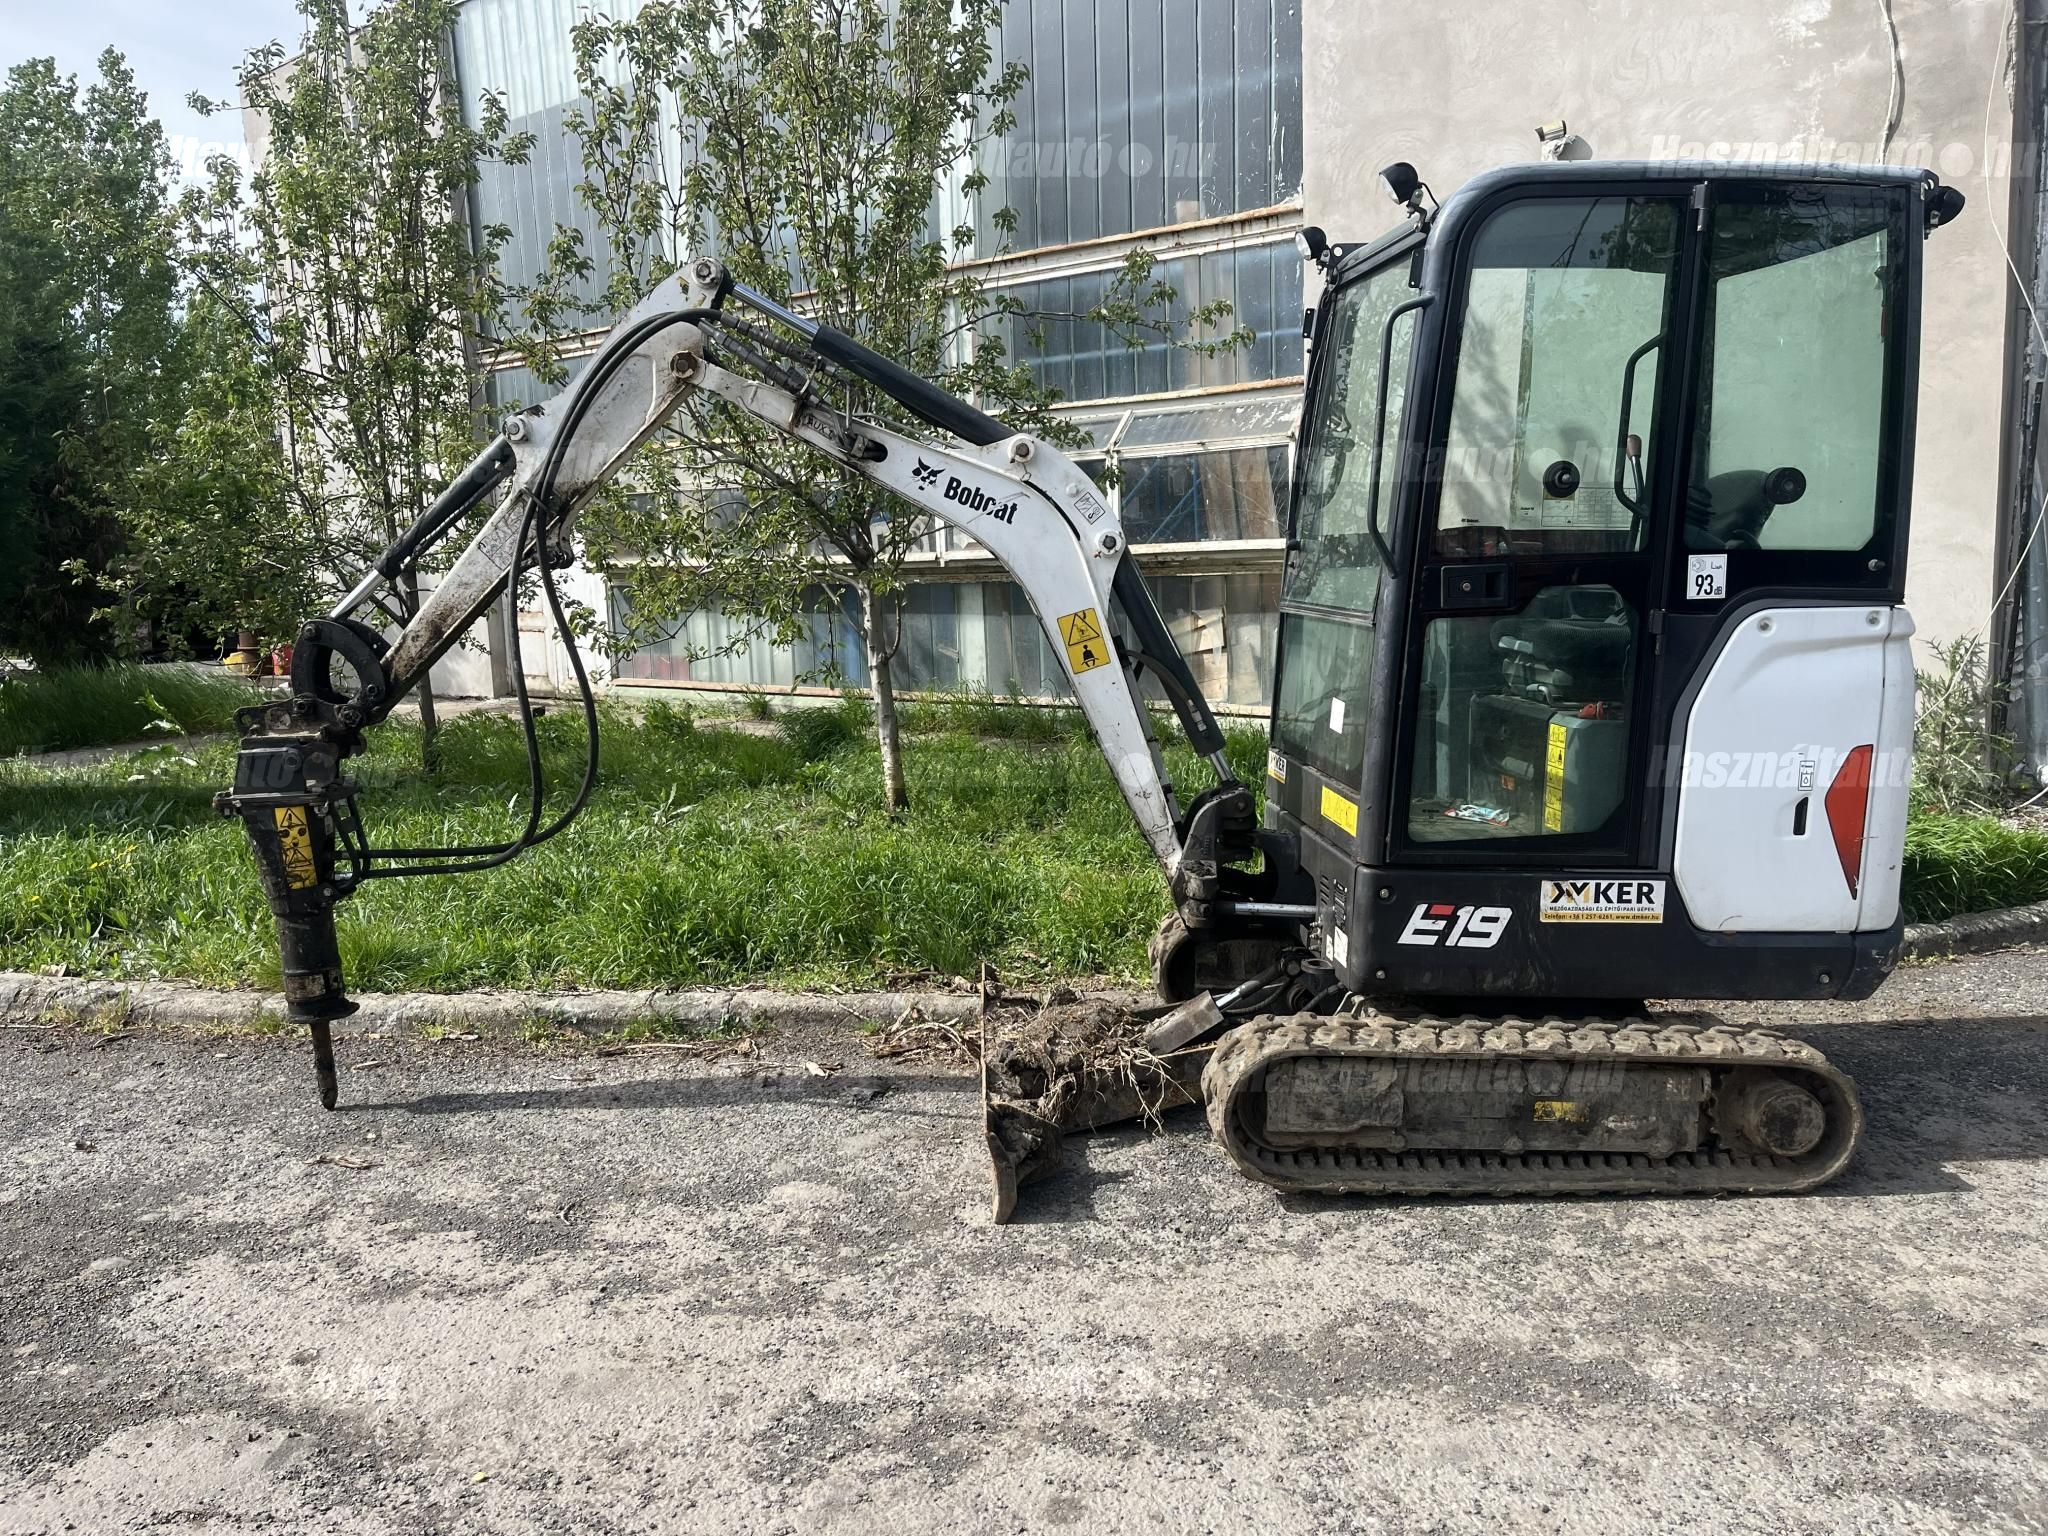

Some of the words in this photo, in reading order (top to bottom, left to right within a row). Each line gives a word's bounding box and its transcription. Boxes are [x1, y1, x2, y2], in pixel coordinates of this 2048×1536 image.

[943, 475, 1018, 525] Bobcat
[1695, 574, 1714, 596] 93
[1713, 585, 1723, 596] dB
[1397, 903, 1513, 948] E19
